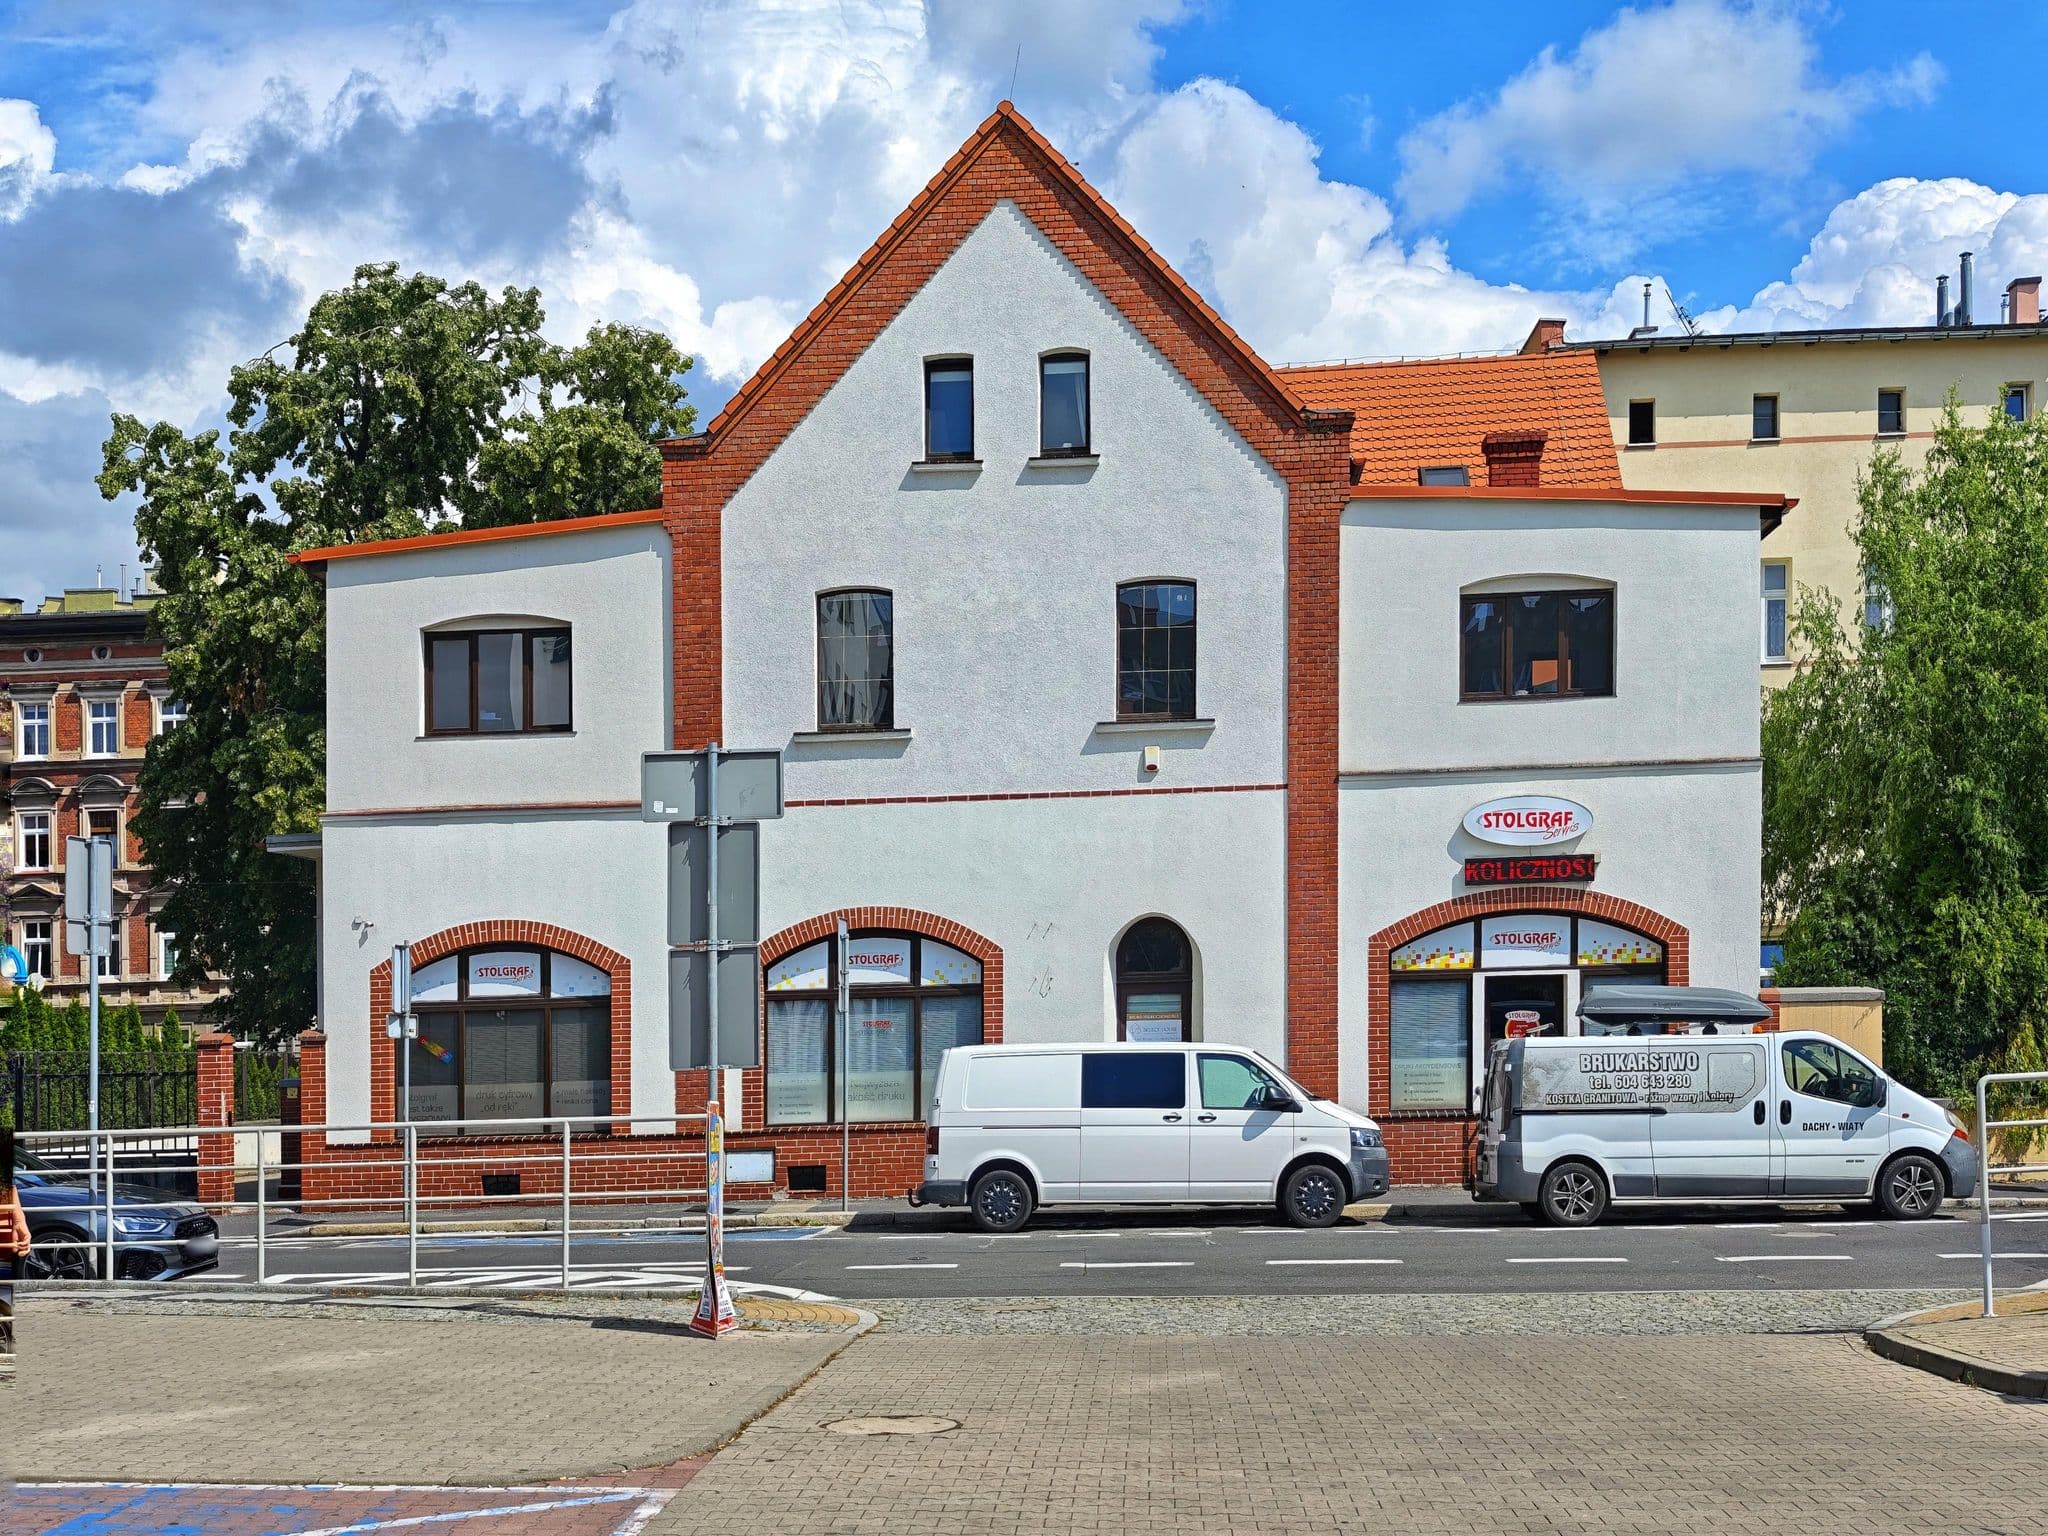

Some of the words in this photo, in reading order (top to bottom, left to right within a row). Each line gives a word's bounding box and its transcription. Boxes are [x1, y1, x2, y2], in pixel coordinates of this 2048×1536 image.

[1483, 811, 1574, 829] STOLGRAF
[1494, 932, 1557, 945] STOLGRAF
[848, 954, 900, 965] STOLGRAF
[478, 966, 530, 978] STOLGRAF
[1580, 1052, 1700, 1073] BRUKARSTWO
[1589, 1075, 1611, 1089] tel.
[1615, 1075, 1638, 1089] 604
[1641, 1075, 1664, 1089] 643
[1667, 1074, 1691, 1088] 280
[1546, 1094, 1581, 1105] KOSTKA
[1583, 1093, 1637, 1104] GRANITOWA
[1671, 1093, 1698, 1105] wzory
[1705, 1090, 1735, 1104] kolory
[1802, 1122, 1831, 1132] DACHY
[1837, 1122, 1865, 1131] WIATY
